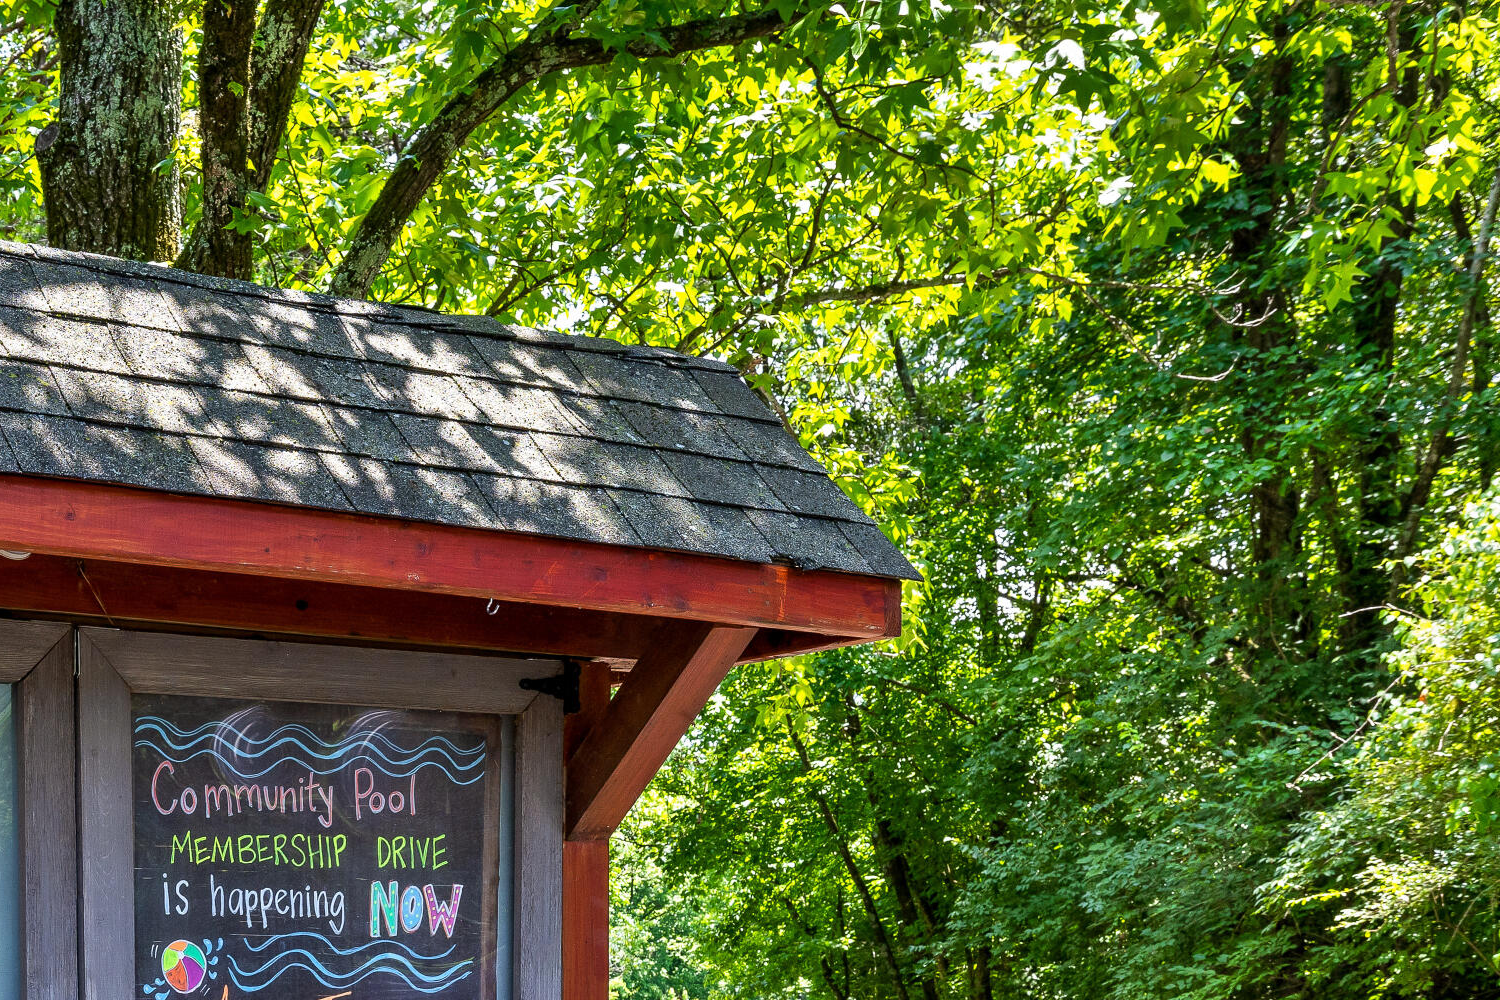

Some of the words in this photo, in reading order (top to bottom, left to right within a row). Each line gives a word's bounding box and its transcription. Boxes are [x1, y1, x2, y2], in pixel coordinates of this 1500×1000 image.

[152, 761, 333, 828] Community
[354, 767, 416, 820] Pool
[170, 830, 347, 869] MEMBERSHIP
[377, 834, 449, 871] DRIVE
[162, 873, 189, 916] is
[210, 875, 345, 935] happening
[370, 880, 464, 939] NOW
